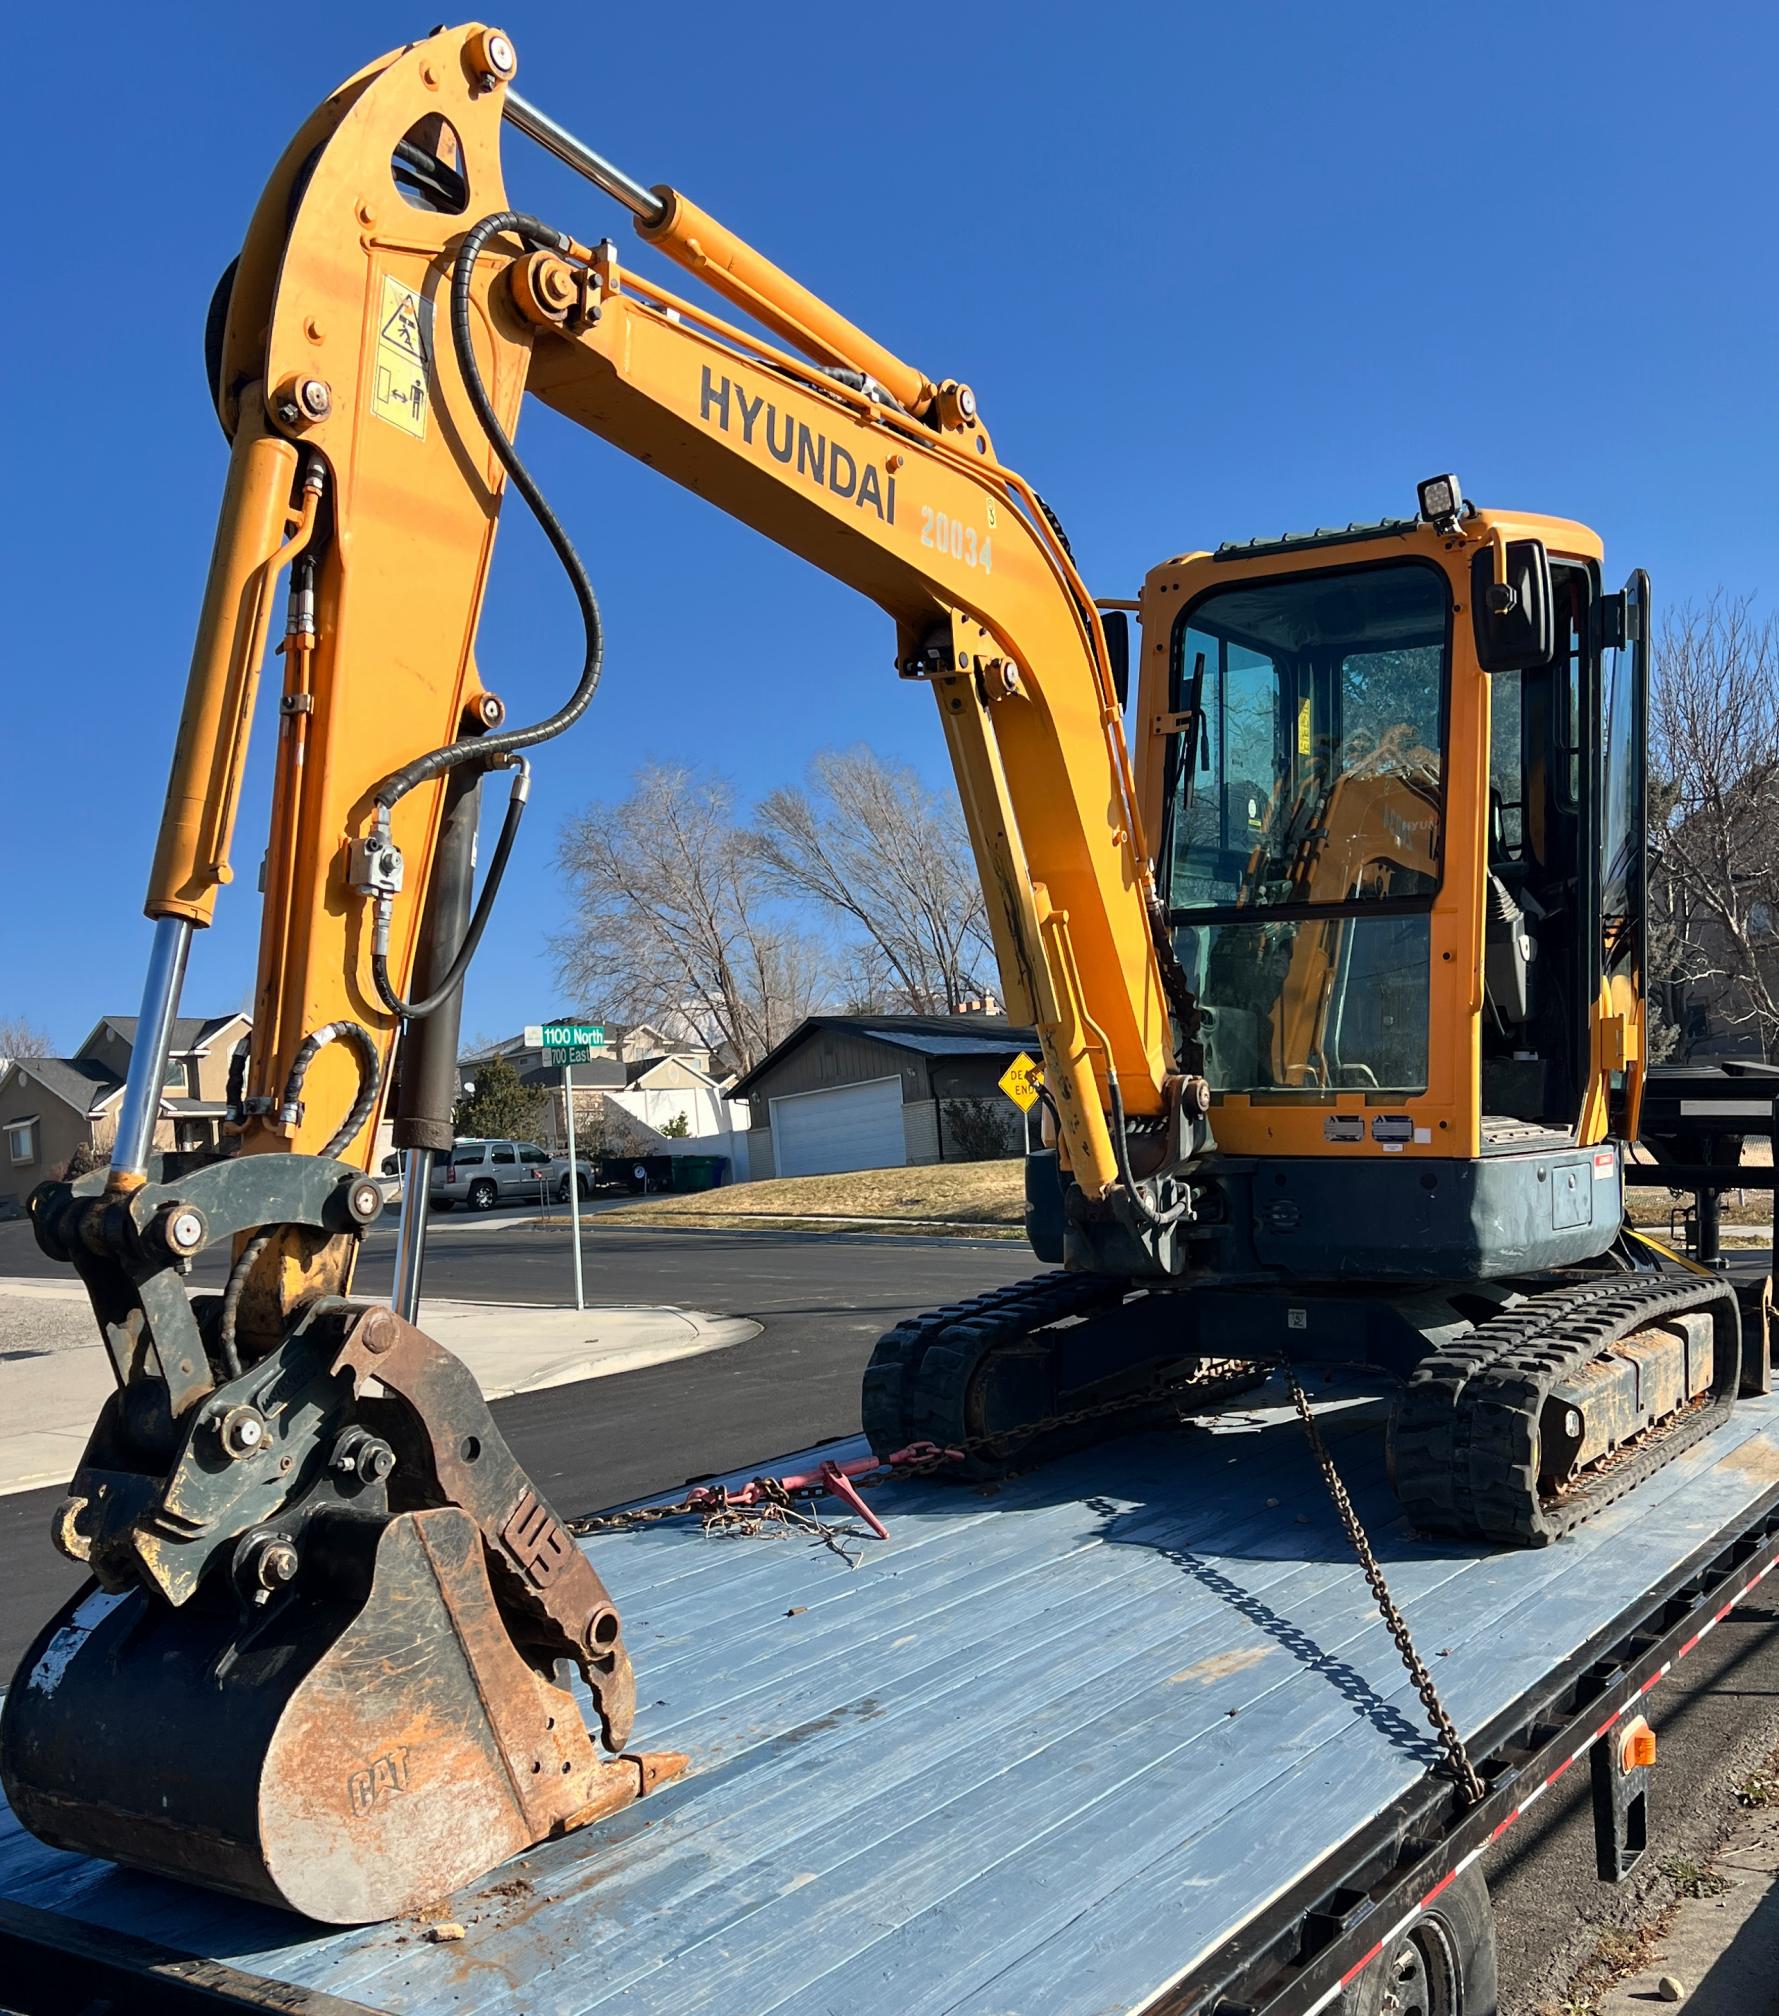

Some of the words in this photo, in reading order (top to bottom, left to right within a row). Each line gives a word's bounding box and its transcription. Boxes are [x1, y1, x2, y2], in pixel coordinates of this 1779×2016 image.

[700, 364, 896, 525] HYUNDAI
[920, 504, 992, 575] 20034
[544, 1028, 570, 1044] 1100
[574, 1028, 603, 1044] North
[551, 1048, 566, 1064] 700
[569, 1046, 590, 1062] East
[348, 1746, 409, 1818] CAT
